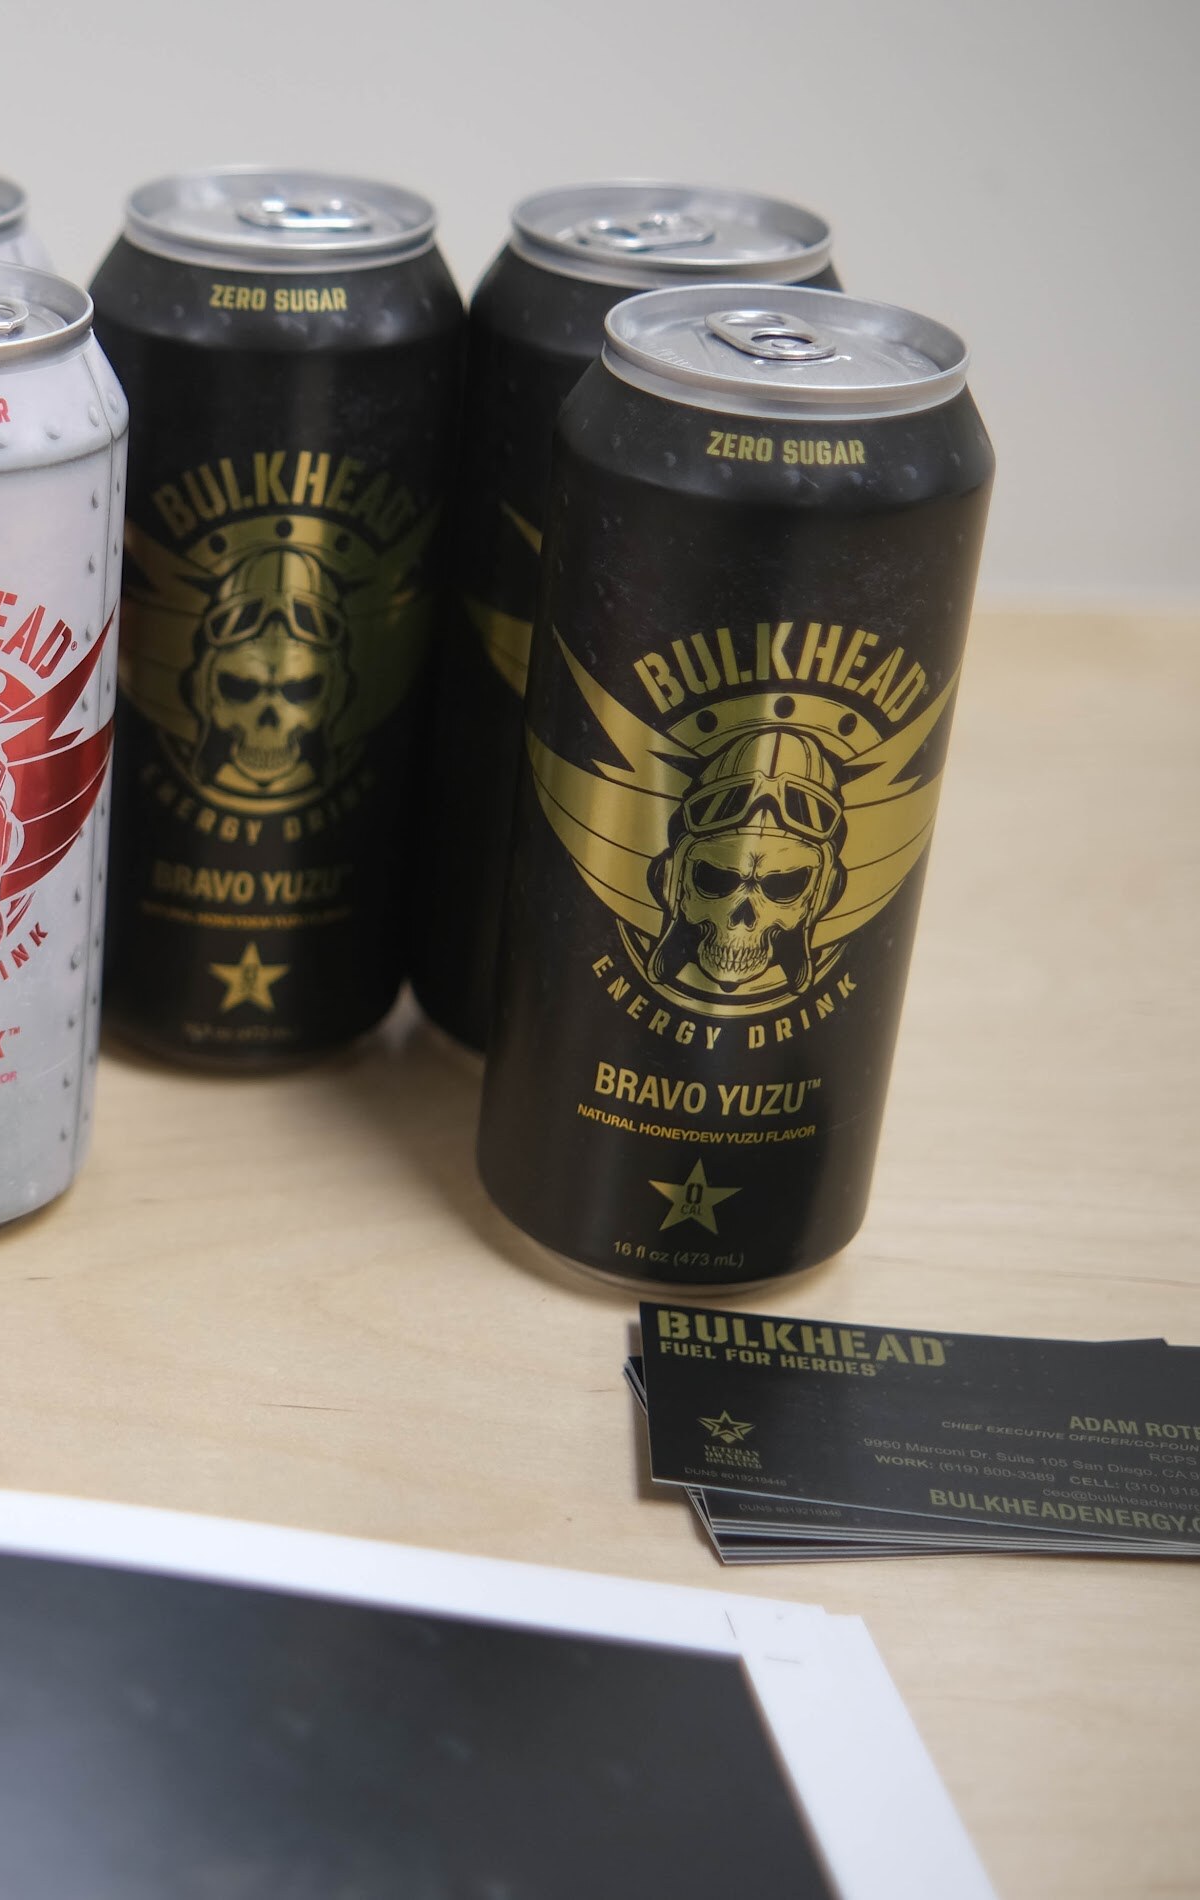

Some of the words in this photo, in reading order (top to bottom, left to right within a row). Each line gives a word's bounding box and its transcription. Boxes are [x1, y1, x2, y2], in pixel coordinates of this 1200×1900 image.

[209, 283, 267, 312] ZERO
[274, 287, 347, 313] SUGAR
[706, 430, 773, 462] ZERO
[782, 439, 867, 465] SUGAR
[592, 954, 721, 1050] ENERGY
[749, 972, 857, 1049] DRINK
[594, 1061, 707, 1114] BRAVO
[577, 1103, 637, 1132] NATURAL
[639, 1122, 724, 1144] HONEYDEW
[726, 1131, 763, 1144] YUZU
[766, 1125, 816, 1143] FLAVOR
[685, 1182, 703, 1205] 0
[614, 1240, 632, 1256] 16
[636, 1245, 646, 1259] fl
[650, 1251, 669, 1263] oz
[673, 1251, 710, 1267] (473
[714, 1252, 745, 1267] mL)
[660, 1340, 717, 1360] FUEL
[726, 1348, 771, 1366] FOR
[780, 1354, 877, 1377] HEROES
[941, 1421, 983, 1433] CHIEF
[987, 1425, 1064, 1441] EXECUTIVE
[1069, 1415, 1139, 1436] ADAM
[684, 1467, 718, 1478] DUNS
[863, 1437, 900, 1450] 9950
[905, 1442, 966, 1457] Marconi
[970, 1450, 992, 1460] Dr.
[997, 1452, 1035, 1465] Suite
[1040, 1457, 1068, 1468] 105
[1072, 1459, 1102, 1472] San
[1161, 1467, 1189, 1480] CA
[874, 1454, 933, 1470] WORK:
[939, 1461, 979, 1476] (619)
[1069, 1475, 1119, 1490] CELL:
[1125, 1480, 1165, 1496] (310)
